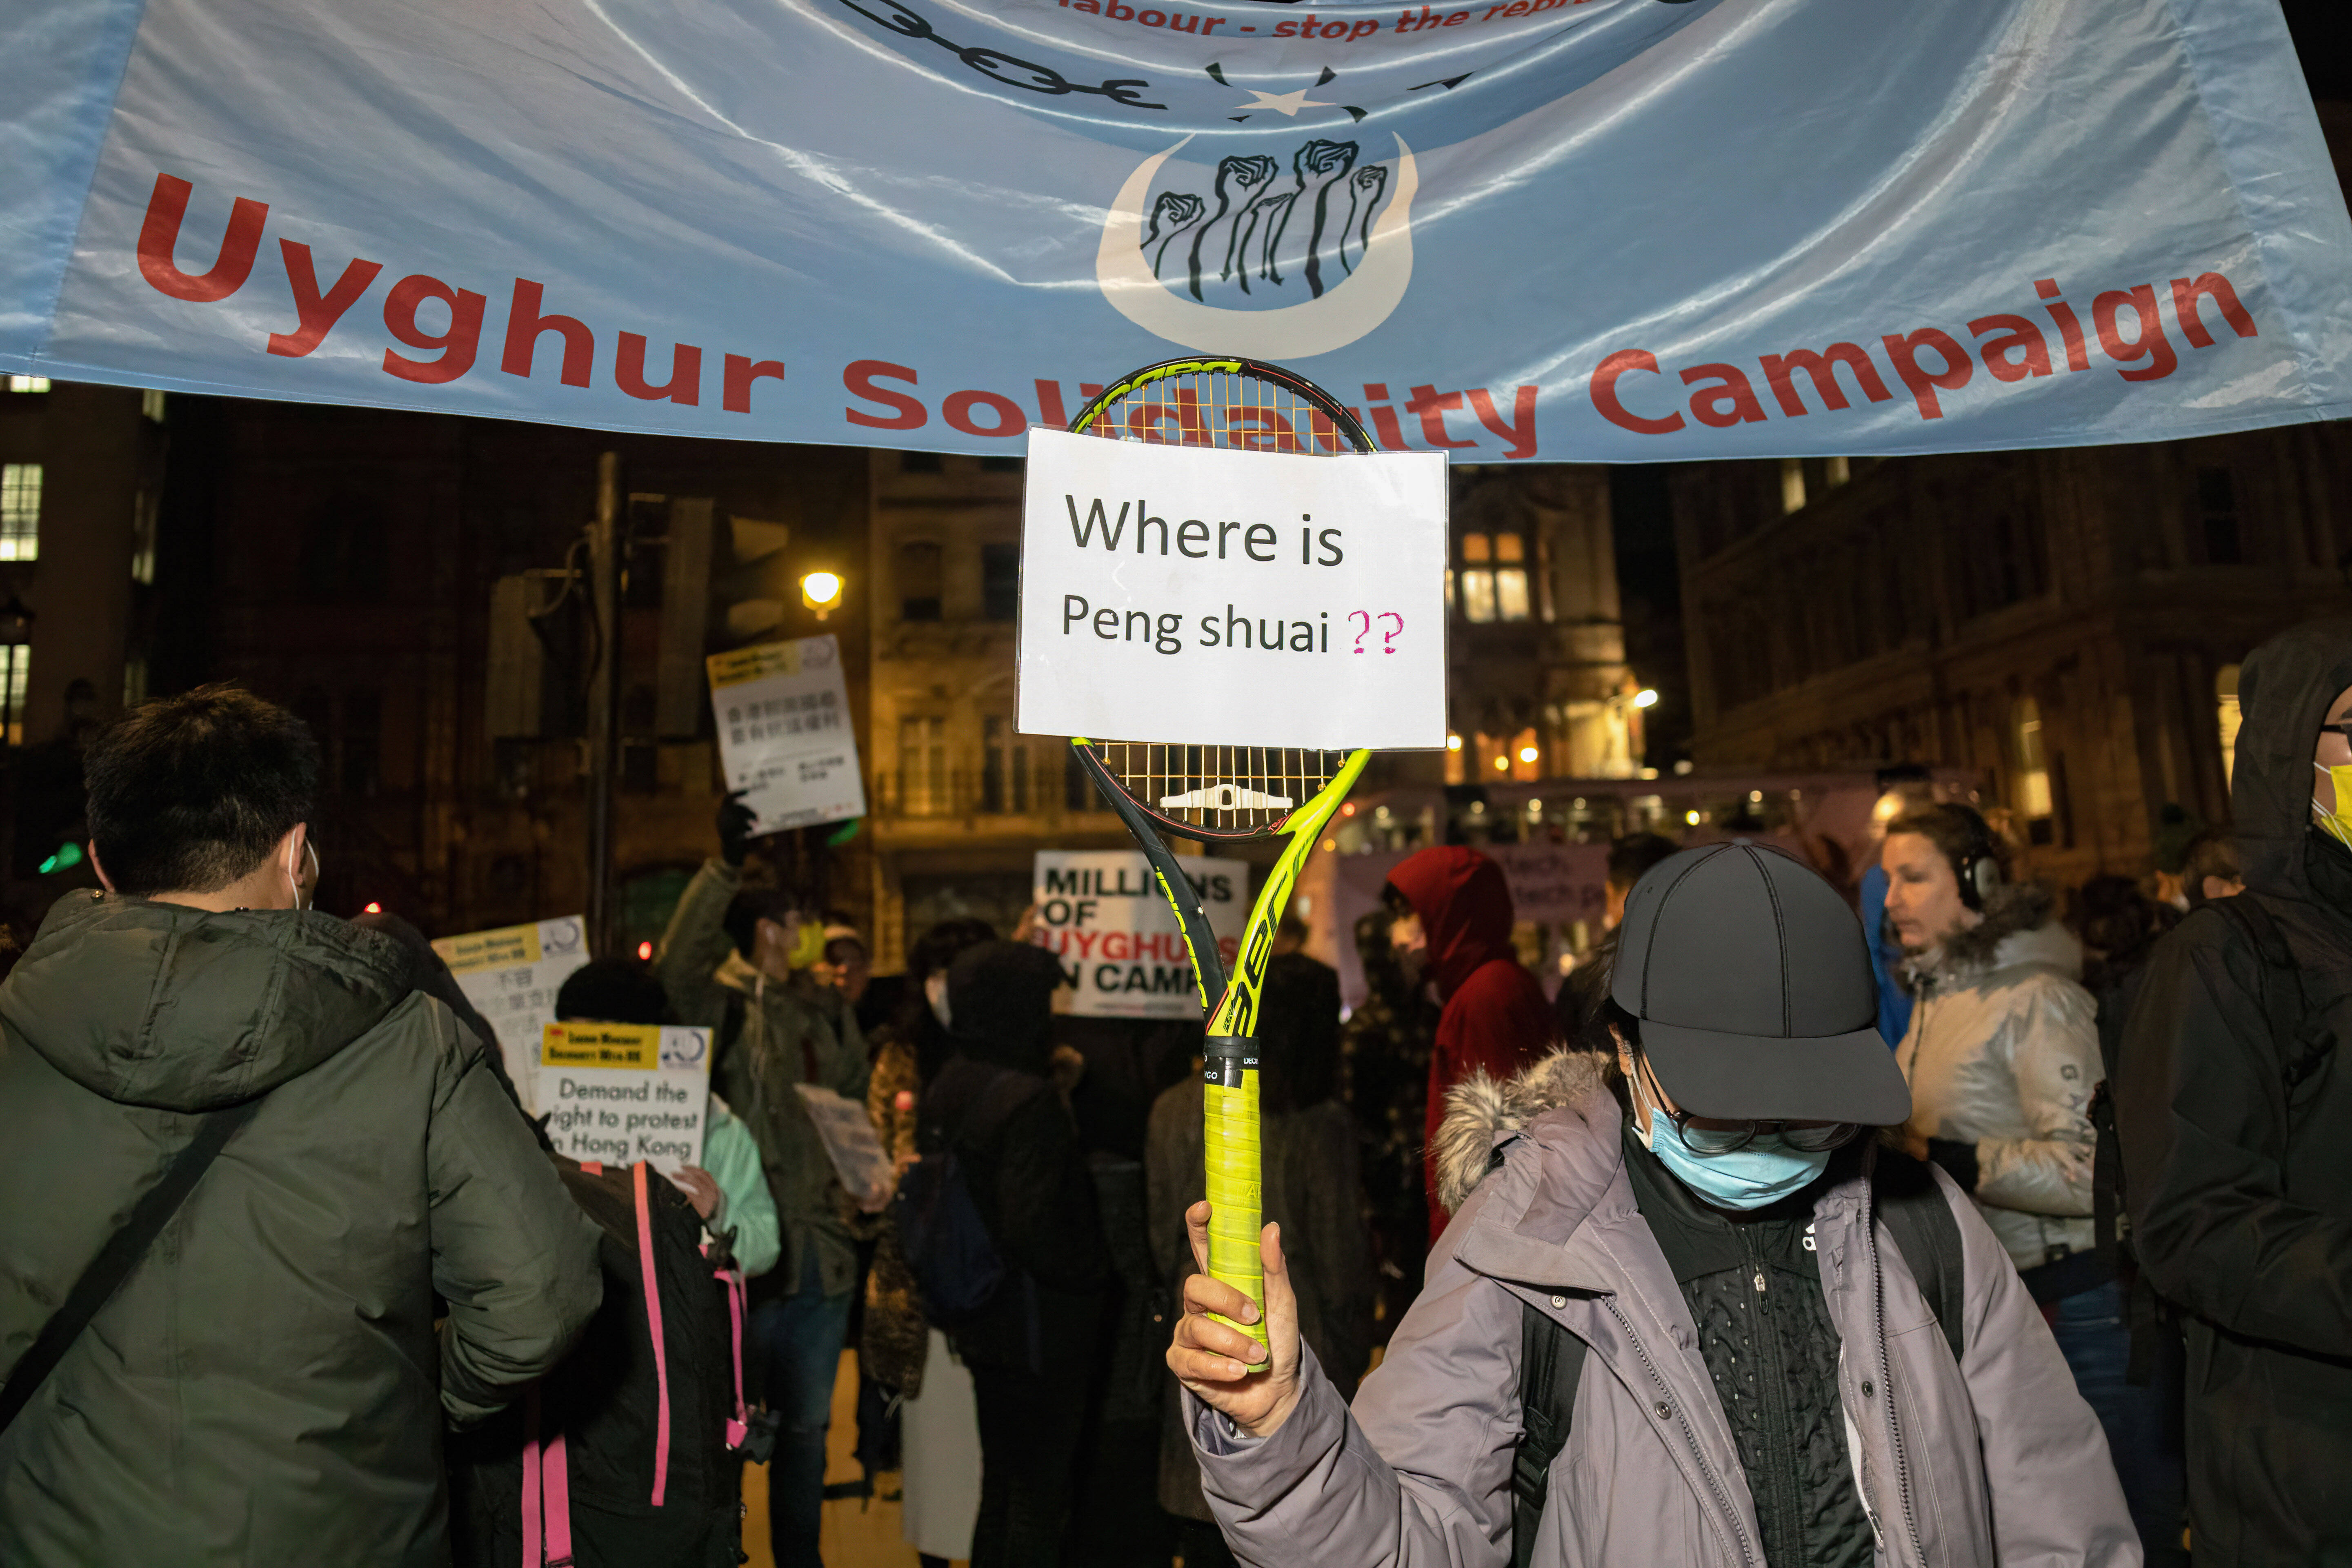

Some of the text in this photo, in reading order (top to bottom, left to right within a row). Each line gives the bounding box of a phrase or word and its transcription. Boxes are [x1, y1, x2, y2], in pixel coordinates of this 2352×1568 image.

[1059, 0, 1226, 36] abour
[1272, 15, 1379, 42] stop
[1394, 5, 1470, 33] the
[137, 172, 785, 414] Uyghur
[1589, 271, 2258, 435] Campaign
[1065, 494, 1343, 567] Where is
[1064, 594, 1405, 655] Peng shuai ??
[1046, 868, 1232, 903] MILLINS
[1043, 899, 1098, 926] OF
[1043, 929, 1239, 966] UYGHUS
[559, 1077, 688, 1103] Demand the
[553, 1104, 698, 1134] ight to protest
[571, 1131, 629, 1159] Hong
[636, 1134, 693, 1163] Kong
